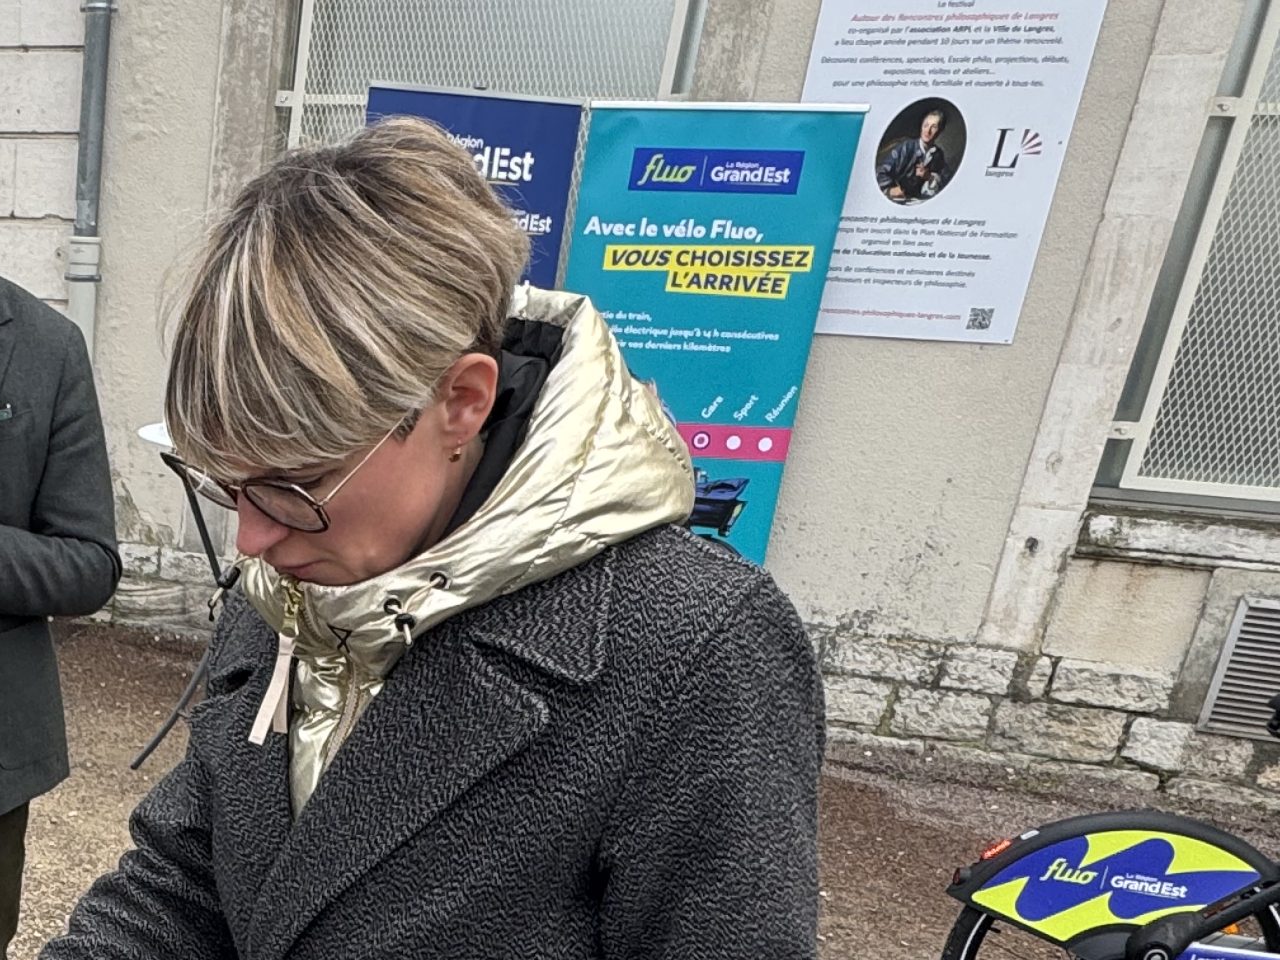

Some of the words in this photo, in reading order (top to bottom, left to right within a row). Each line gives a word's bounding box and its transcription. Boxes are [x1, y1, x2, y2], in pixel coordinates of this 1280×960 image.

[944, 12, 1010, 22] philosophiques
[1011, 12, 1022, 20] de
[1024, 12, 1059, 21] Langres
[637, 153, 697, 186] fluo
[584, 216, 634, 238] Avec
[640, 216, 658, 238] le
[662, 218, 706, 240] vélo
[710, 219, 765, 244] Fluo,
[610, 249, 670, 268] VOUS
[676, 250, 808, 268] CHOISISSEZ
[670, 270, 786, 294] L'ARRIVÉE
[616, 310, 628, 320] du
[628, 311, 652, 322] train,
[624, 326, 669, 338] électrique
[720, 329, 780, 342] consécutives
[645, 340, 682, 351] derniers
[682, 342, 732, 353] kilomètres
[733, 394, 760, 422] Sport
[764, 385, 798, 422] Réunion
[1039, 858, 1098, 885] fluo
